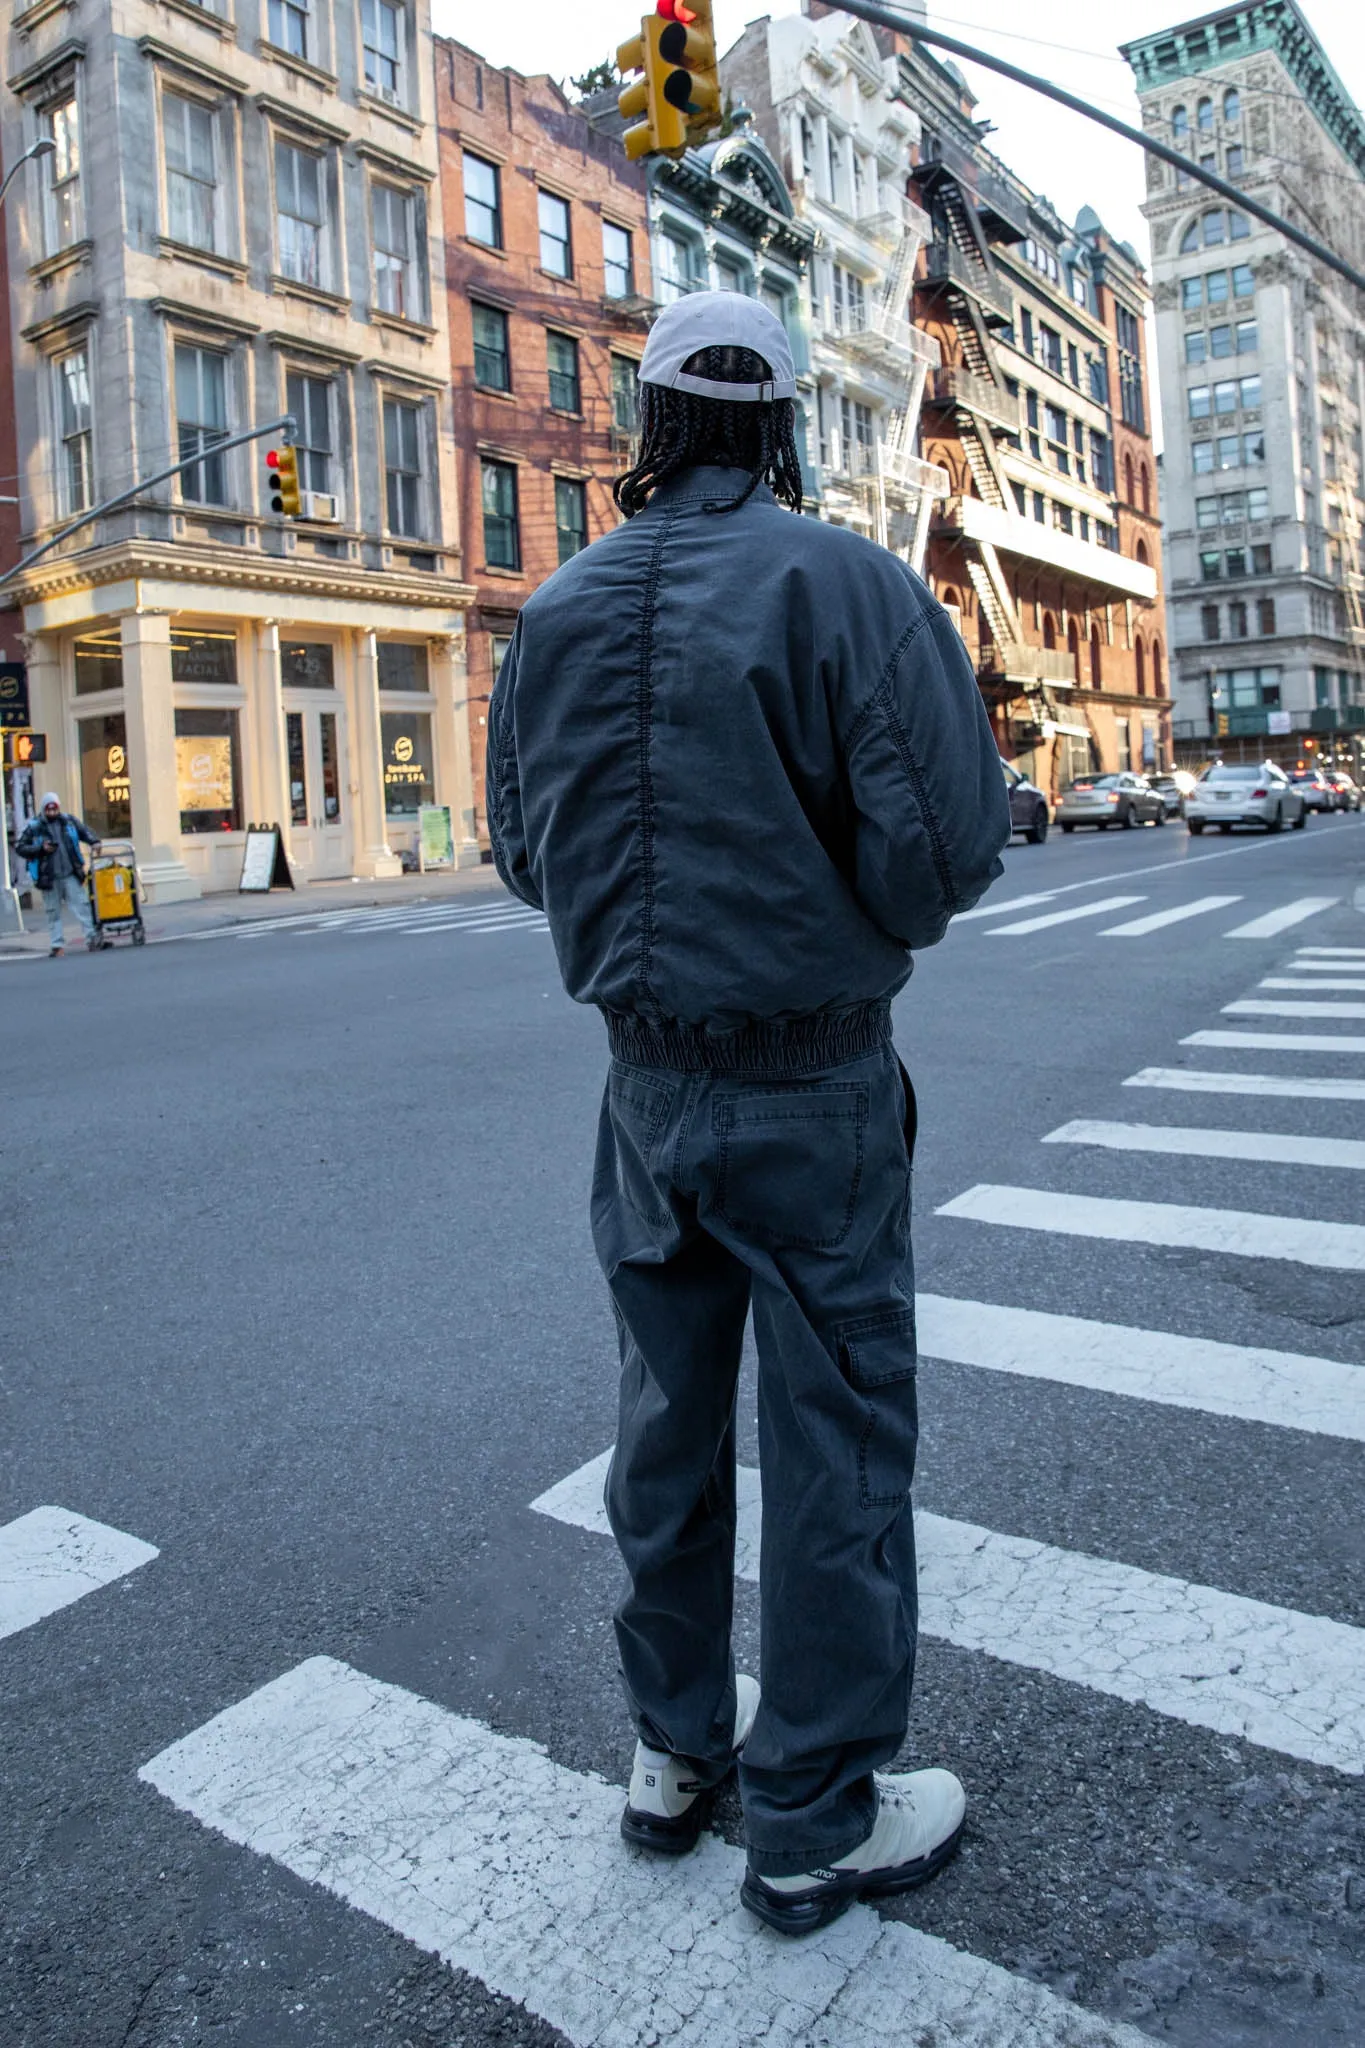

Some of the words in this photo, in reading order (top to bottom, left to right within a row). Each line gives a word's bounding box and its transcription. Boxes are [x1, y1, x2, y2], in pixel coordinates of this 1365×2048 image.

[177, 663, 219, 677] FACIAL
[407, 773, 425, 784] SPA
[108, 788, 129, 802] SPA
[646, 1775, 656, 1788] S
[810, 1868, 837, 1880] mon
